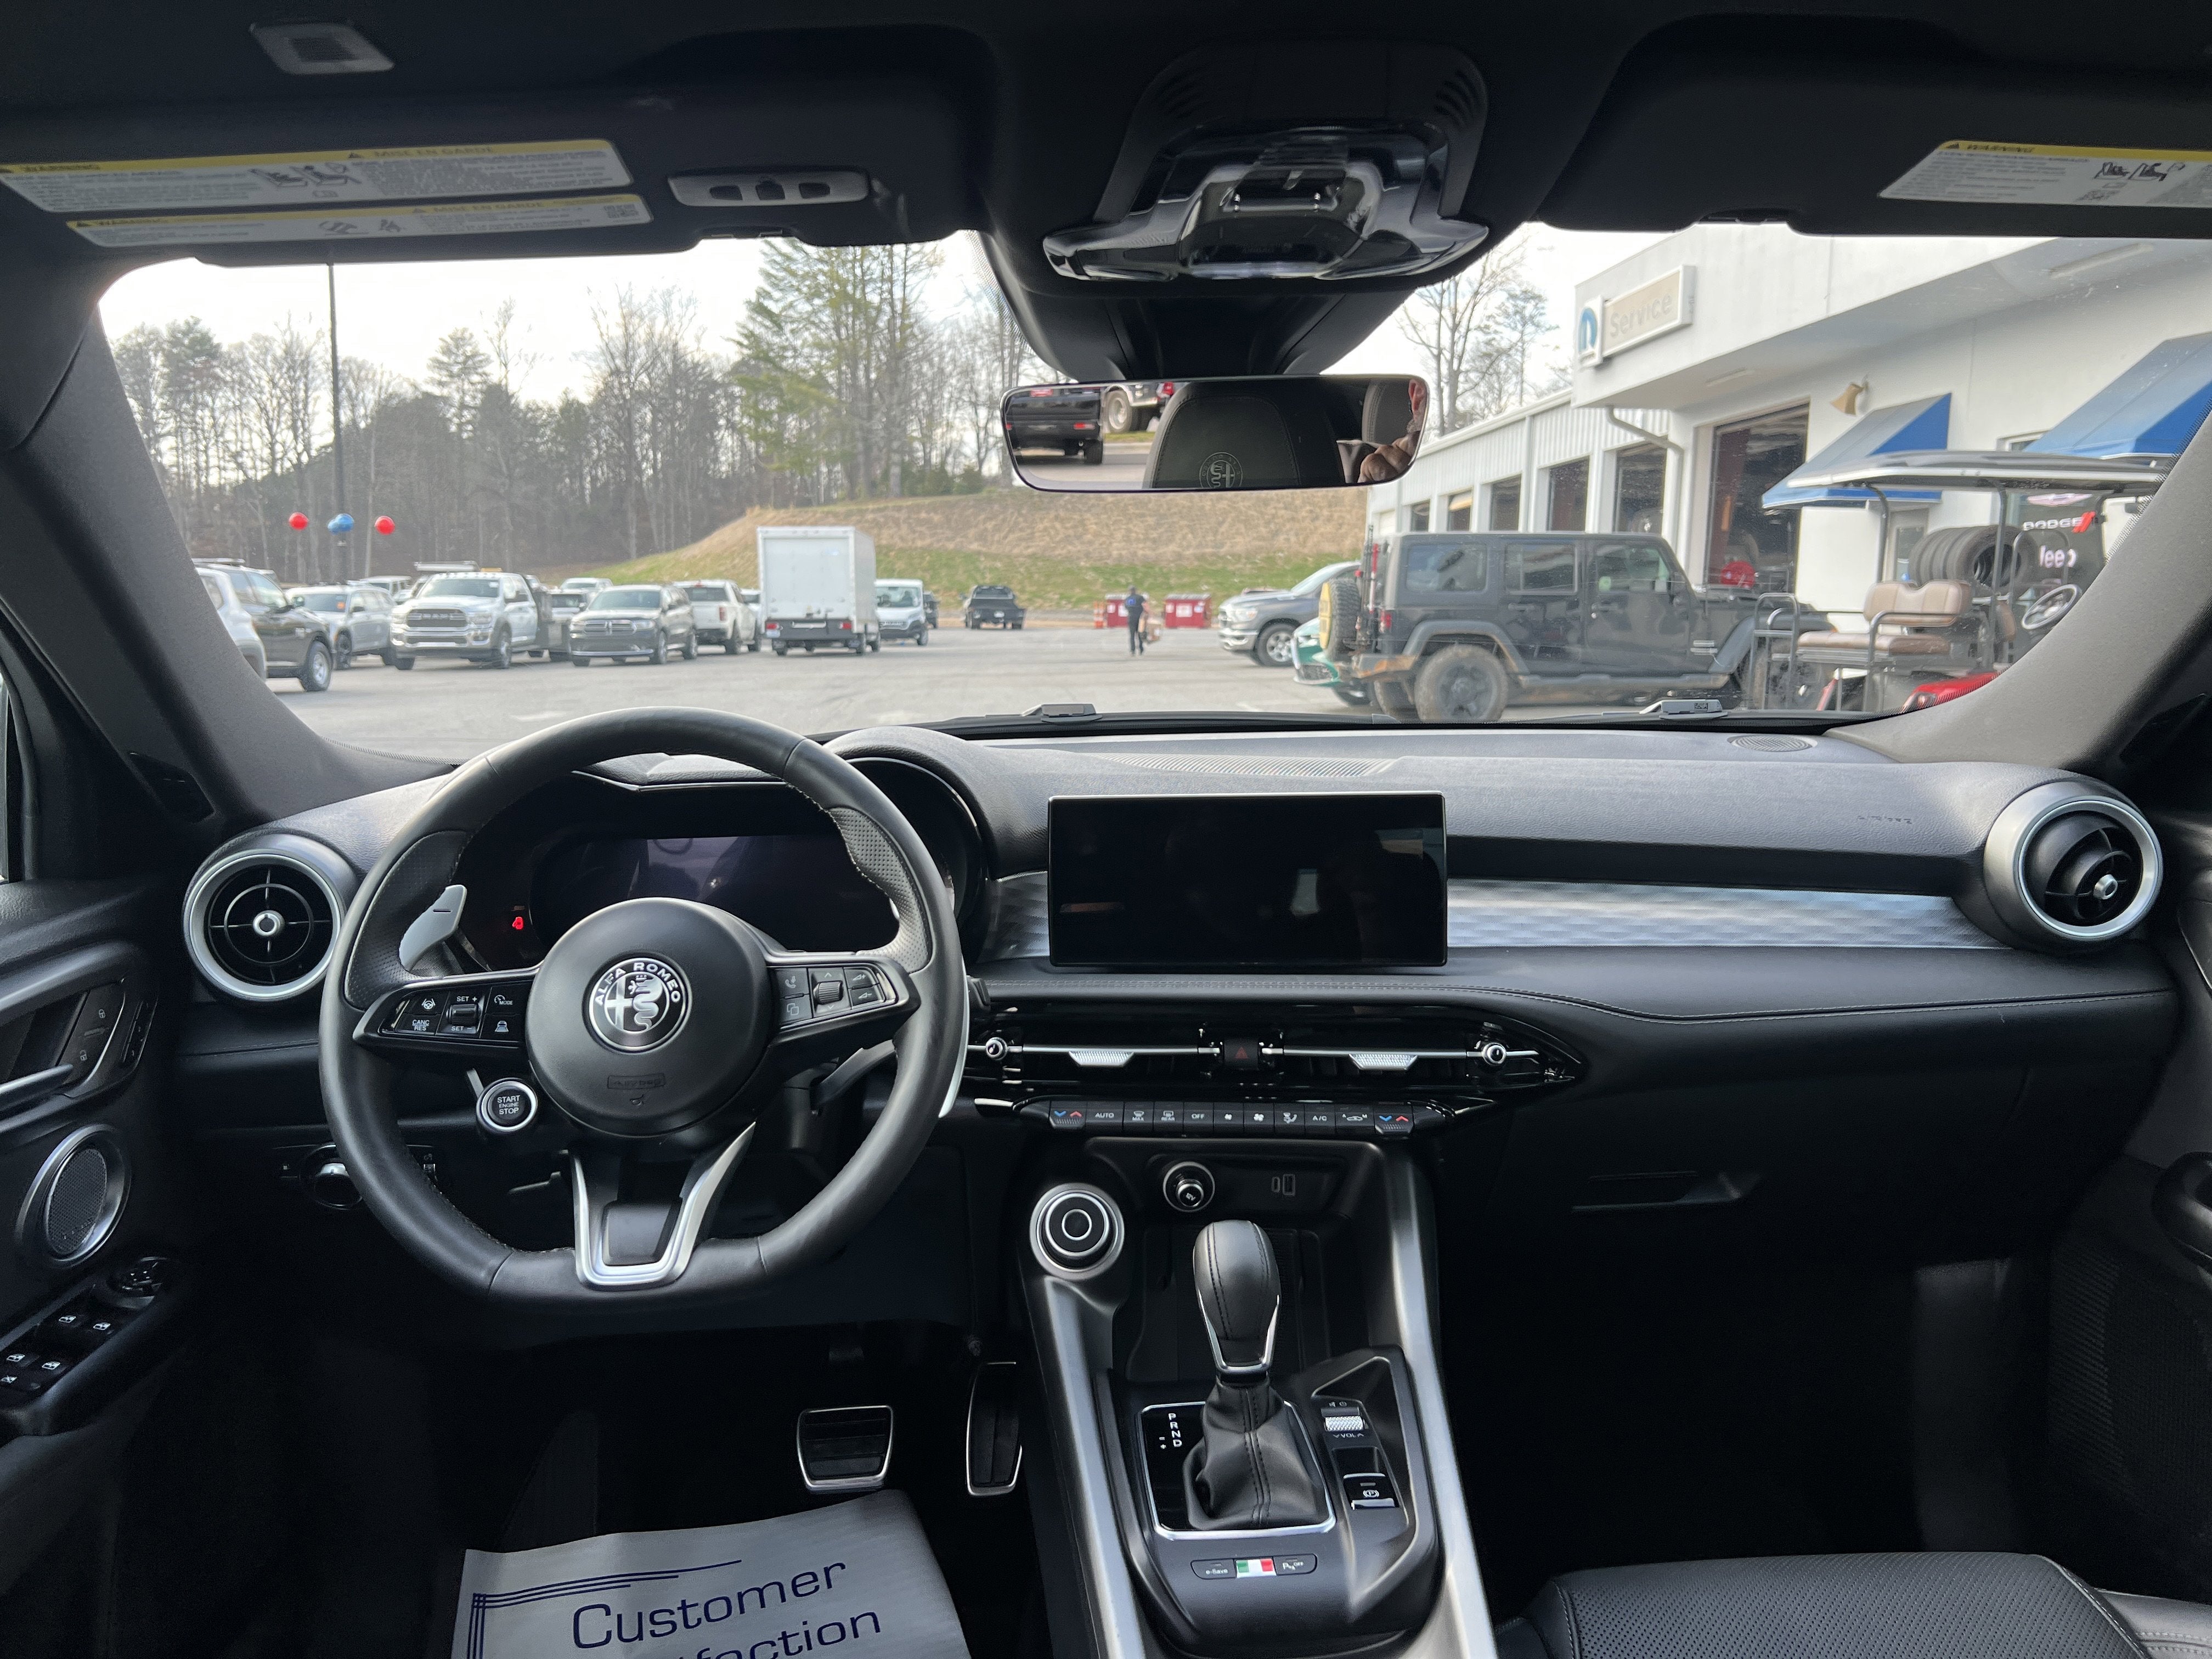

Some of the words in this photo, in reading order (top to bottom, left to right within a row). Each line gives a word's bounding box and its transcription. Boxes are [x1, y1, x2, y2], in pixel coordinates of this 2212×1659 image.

[1609, 293, 1673, 337] Service
[2023, 516, 2084, 531] DODGE
[595, 967, 627, 1006] ALFA
[633, 962, 681, 1003] ROMEO
[497, 1095, 521, 1103] START
[572, 1561, 847, 1650] Customer
